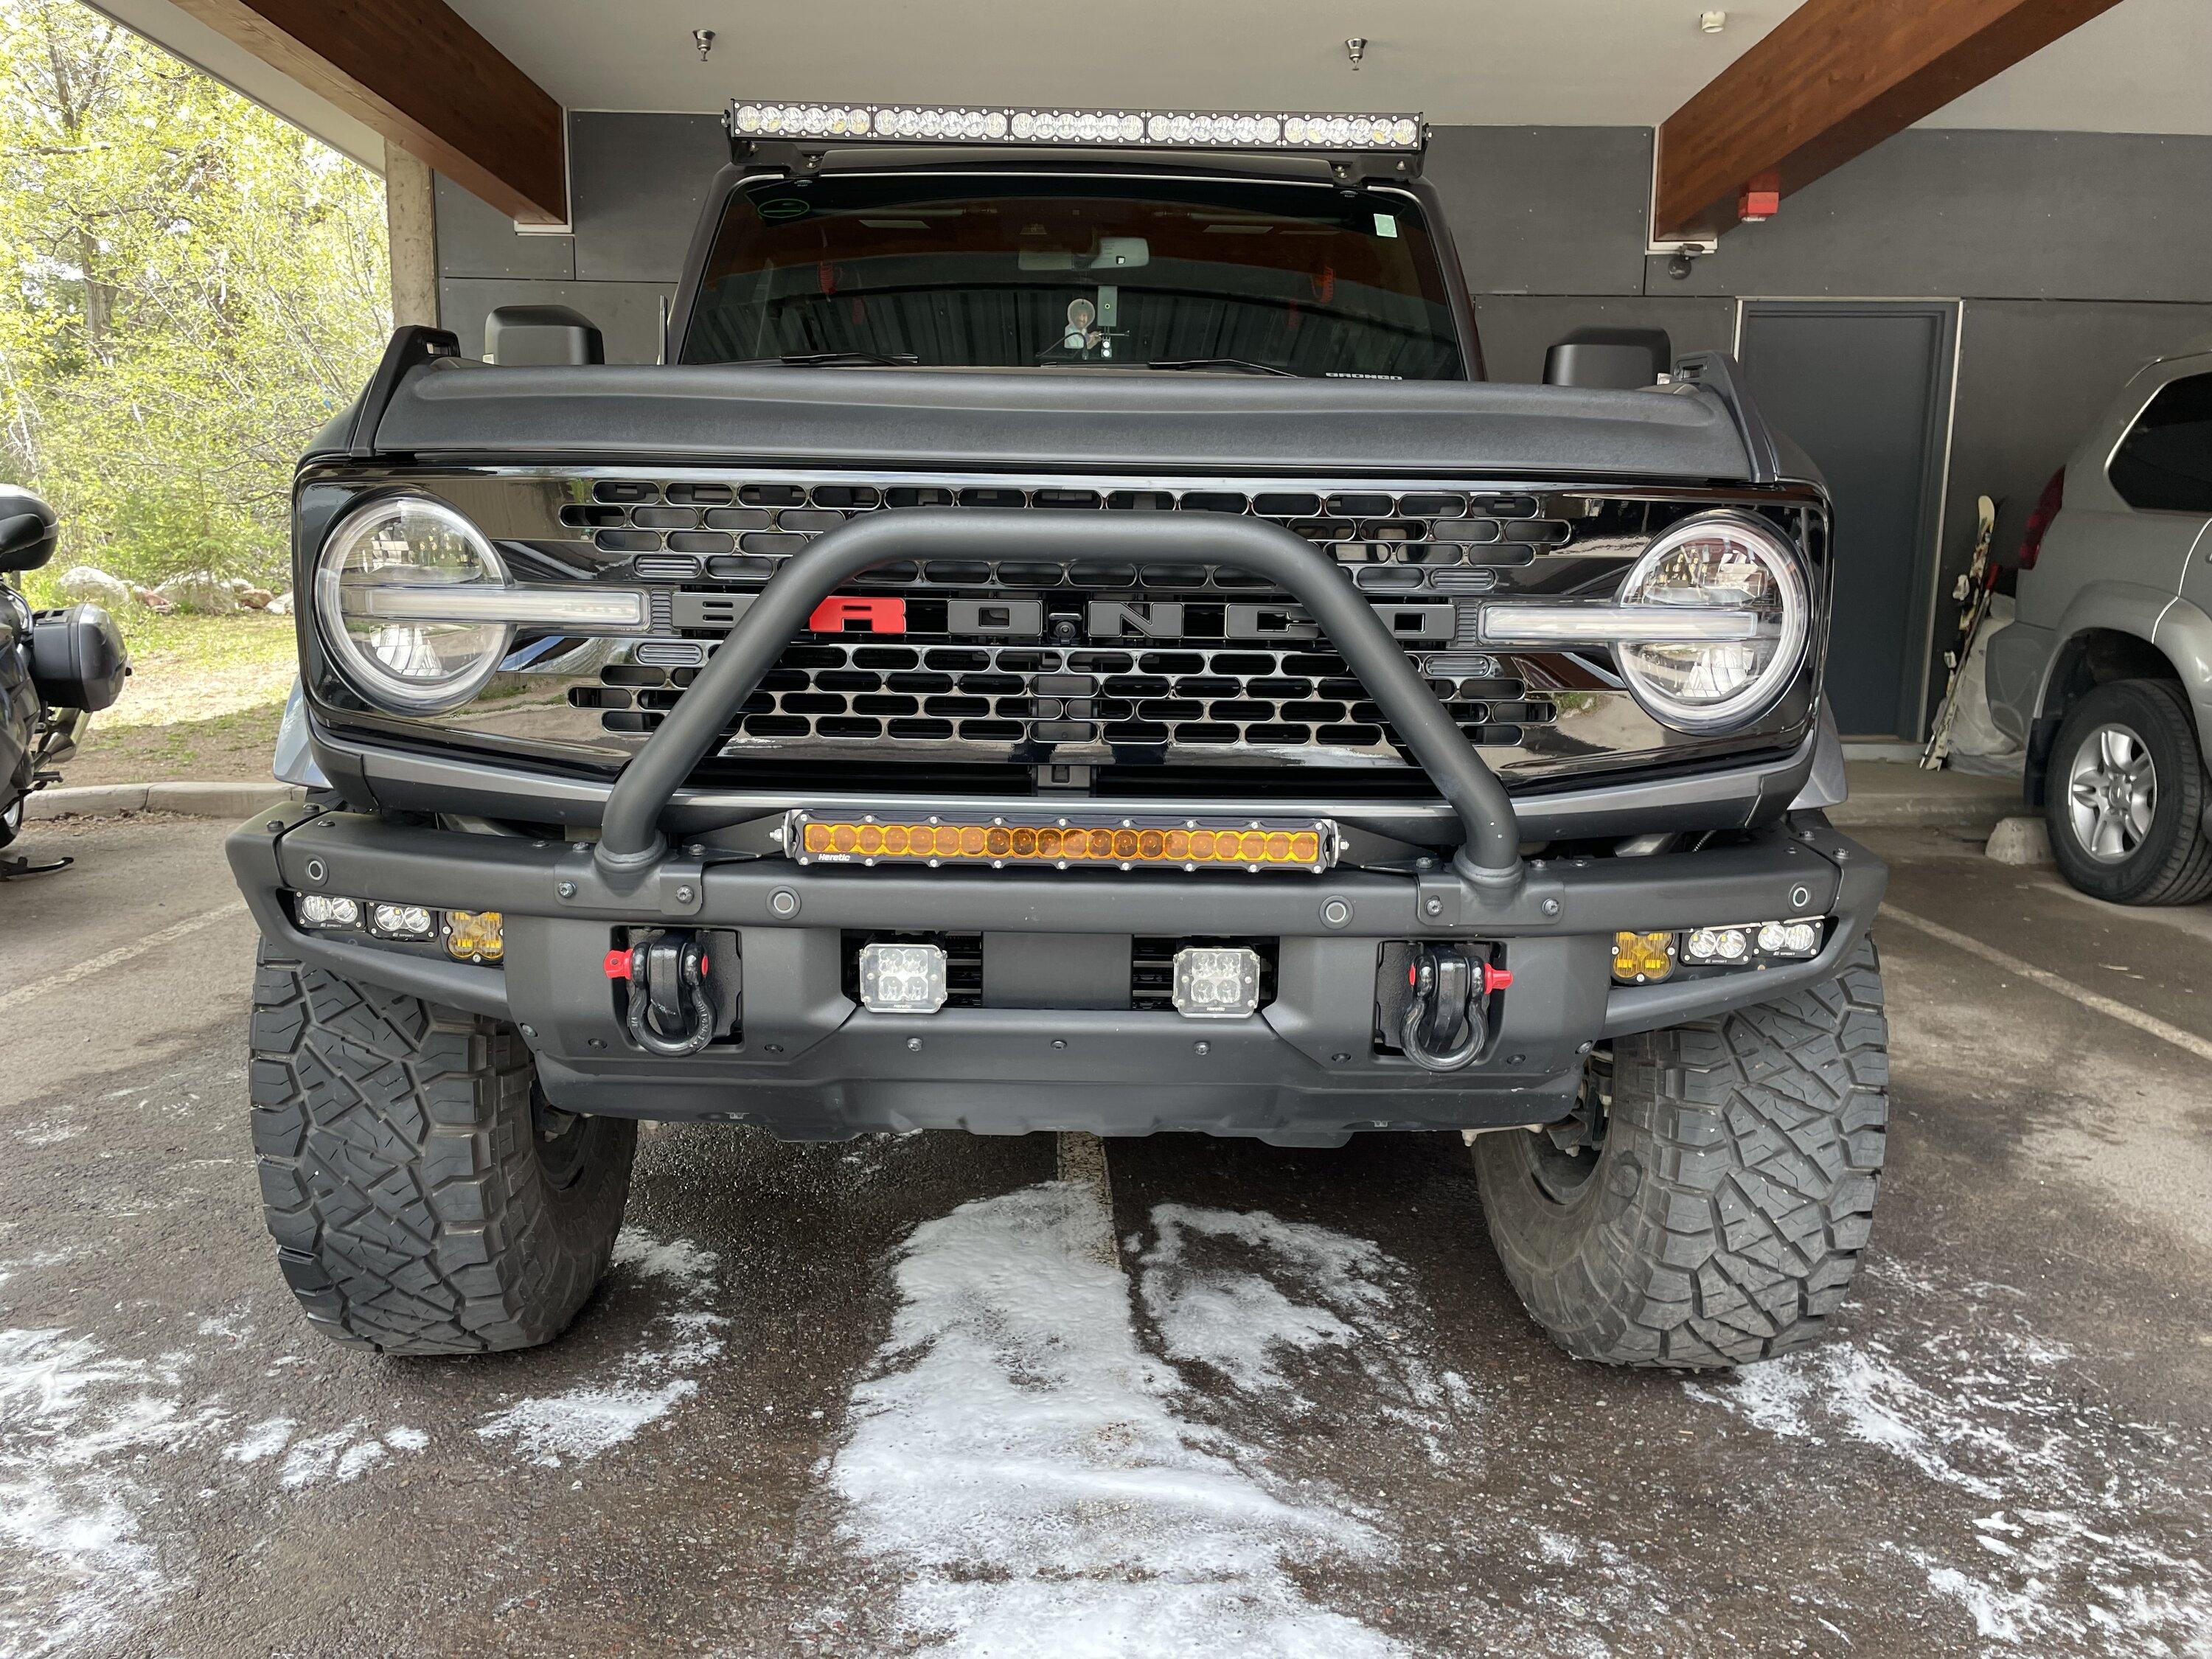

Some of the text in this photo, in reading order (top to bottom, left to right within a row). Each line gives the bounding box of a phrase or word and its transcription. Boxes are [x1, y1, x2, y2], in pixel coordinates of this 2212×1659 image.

[1325, 372, 1402, 380] BRONCO
[672, 591, 1456, 641] BRONCO
[818, 853, 851, 861] Heretic
